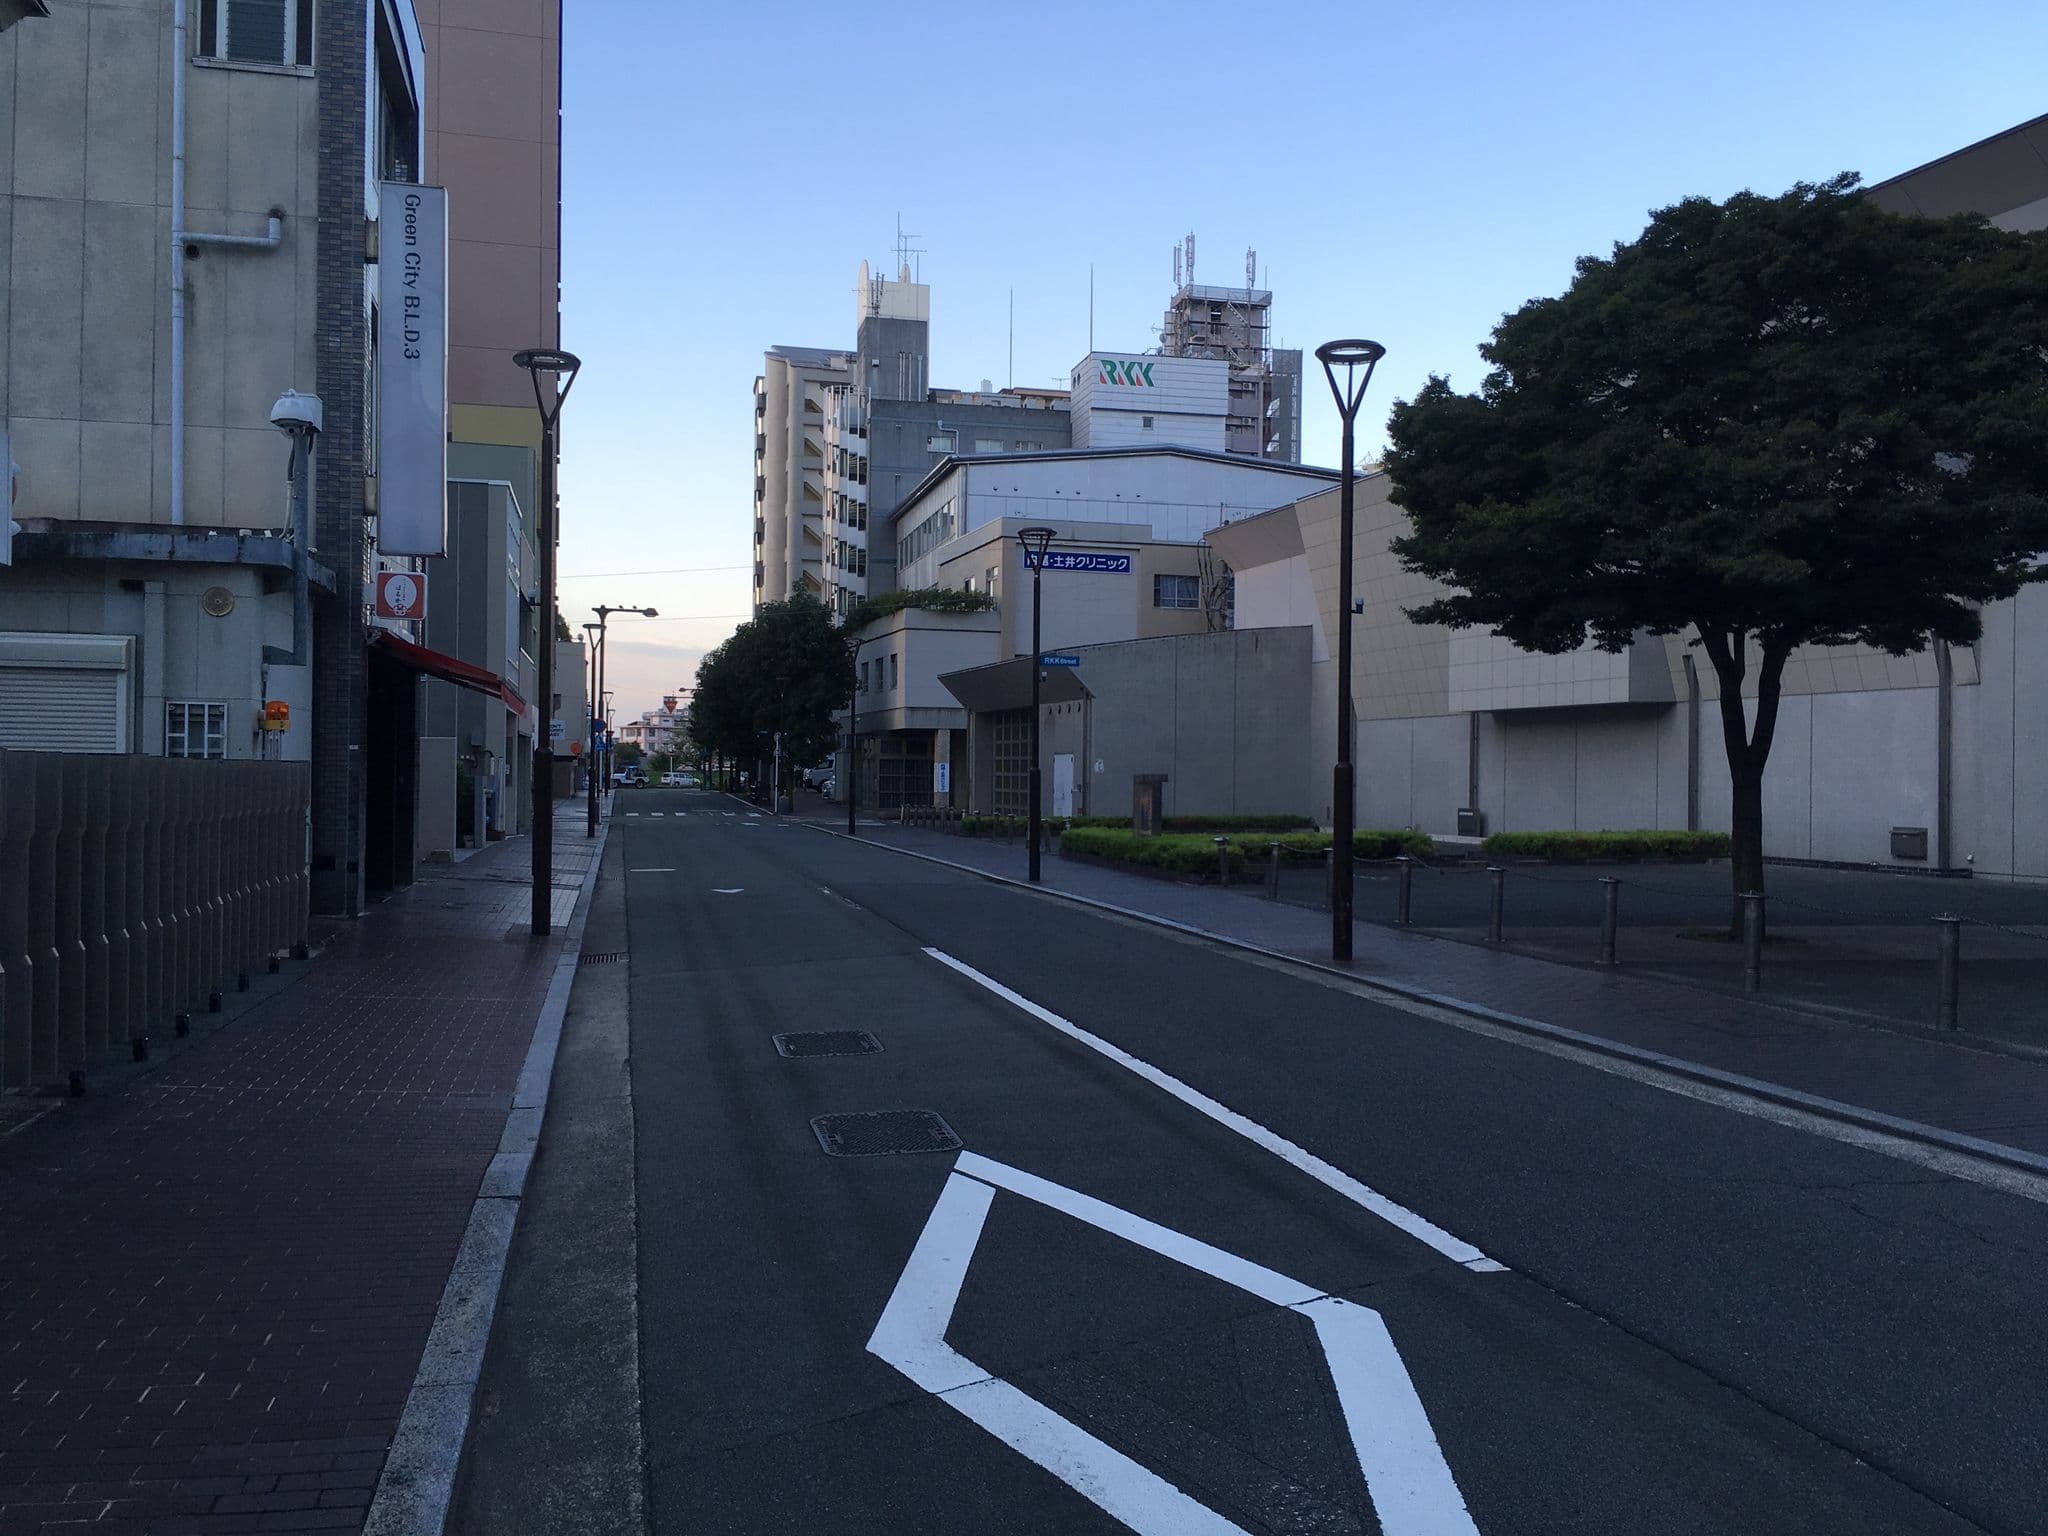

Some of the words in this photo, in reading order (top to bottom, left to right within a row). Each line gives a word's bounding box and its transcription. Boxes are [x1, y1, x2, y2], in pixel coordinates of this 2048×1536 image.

[404, 194, 421, 246] Green
[402, 252, 421, 289] City
[404, 295, 420, 360] B.L.D.3
[1099, 359, 1155, 388] RKK
[1044, 657, 1060, 665] RKK
